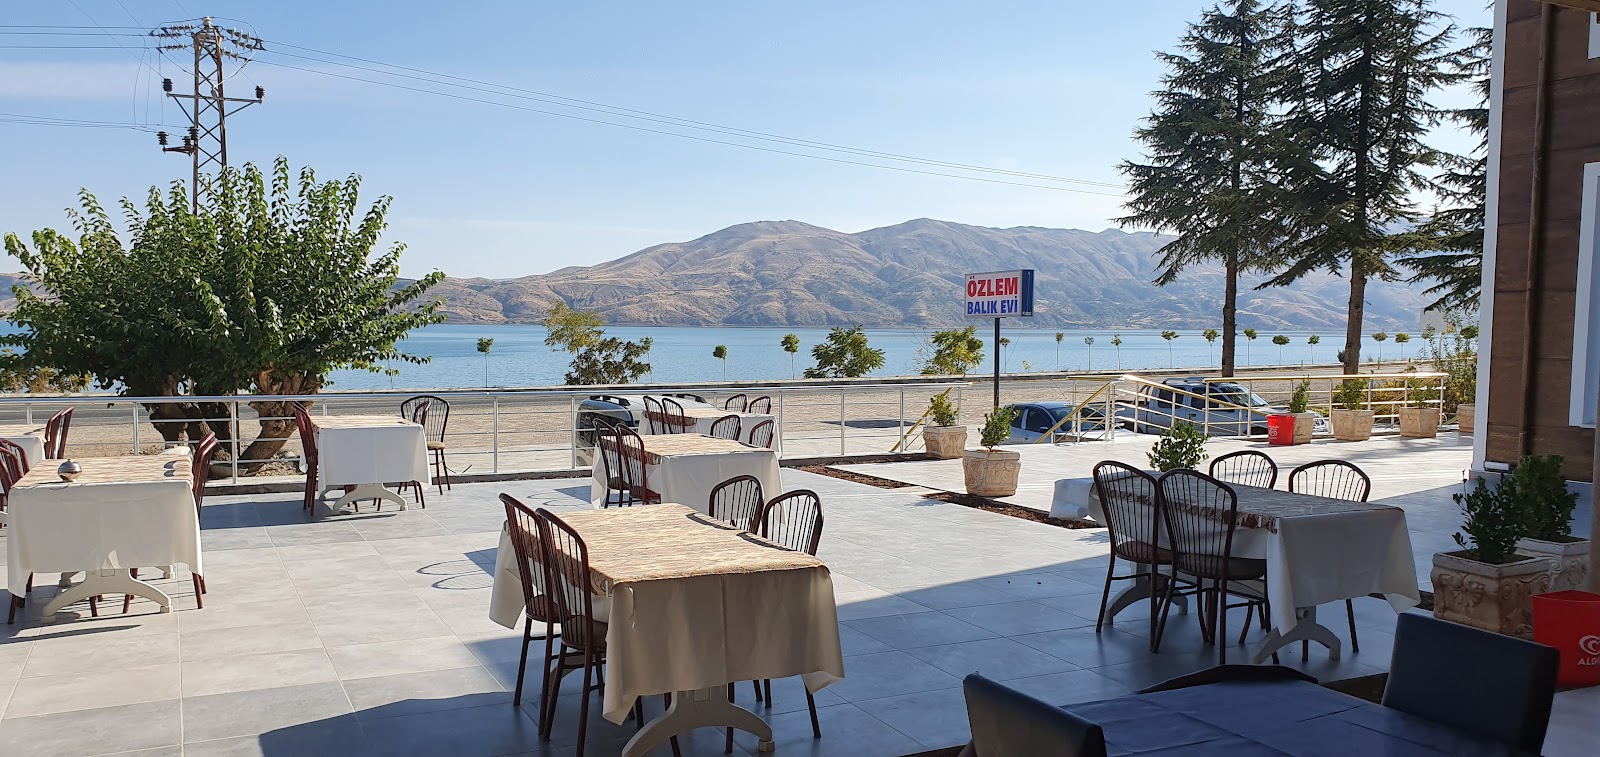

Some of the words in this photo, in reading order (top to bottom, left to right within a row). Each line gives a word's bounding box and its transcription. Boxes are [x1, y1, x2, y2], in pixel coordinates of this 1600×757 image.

[967, 276, 1018, 297] ÖZLEM
[967, 301, 998, 314] BALIK
[1000, 296, 1018, 313] EVİ
[1577, 657, 1600, 665] ALG
